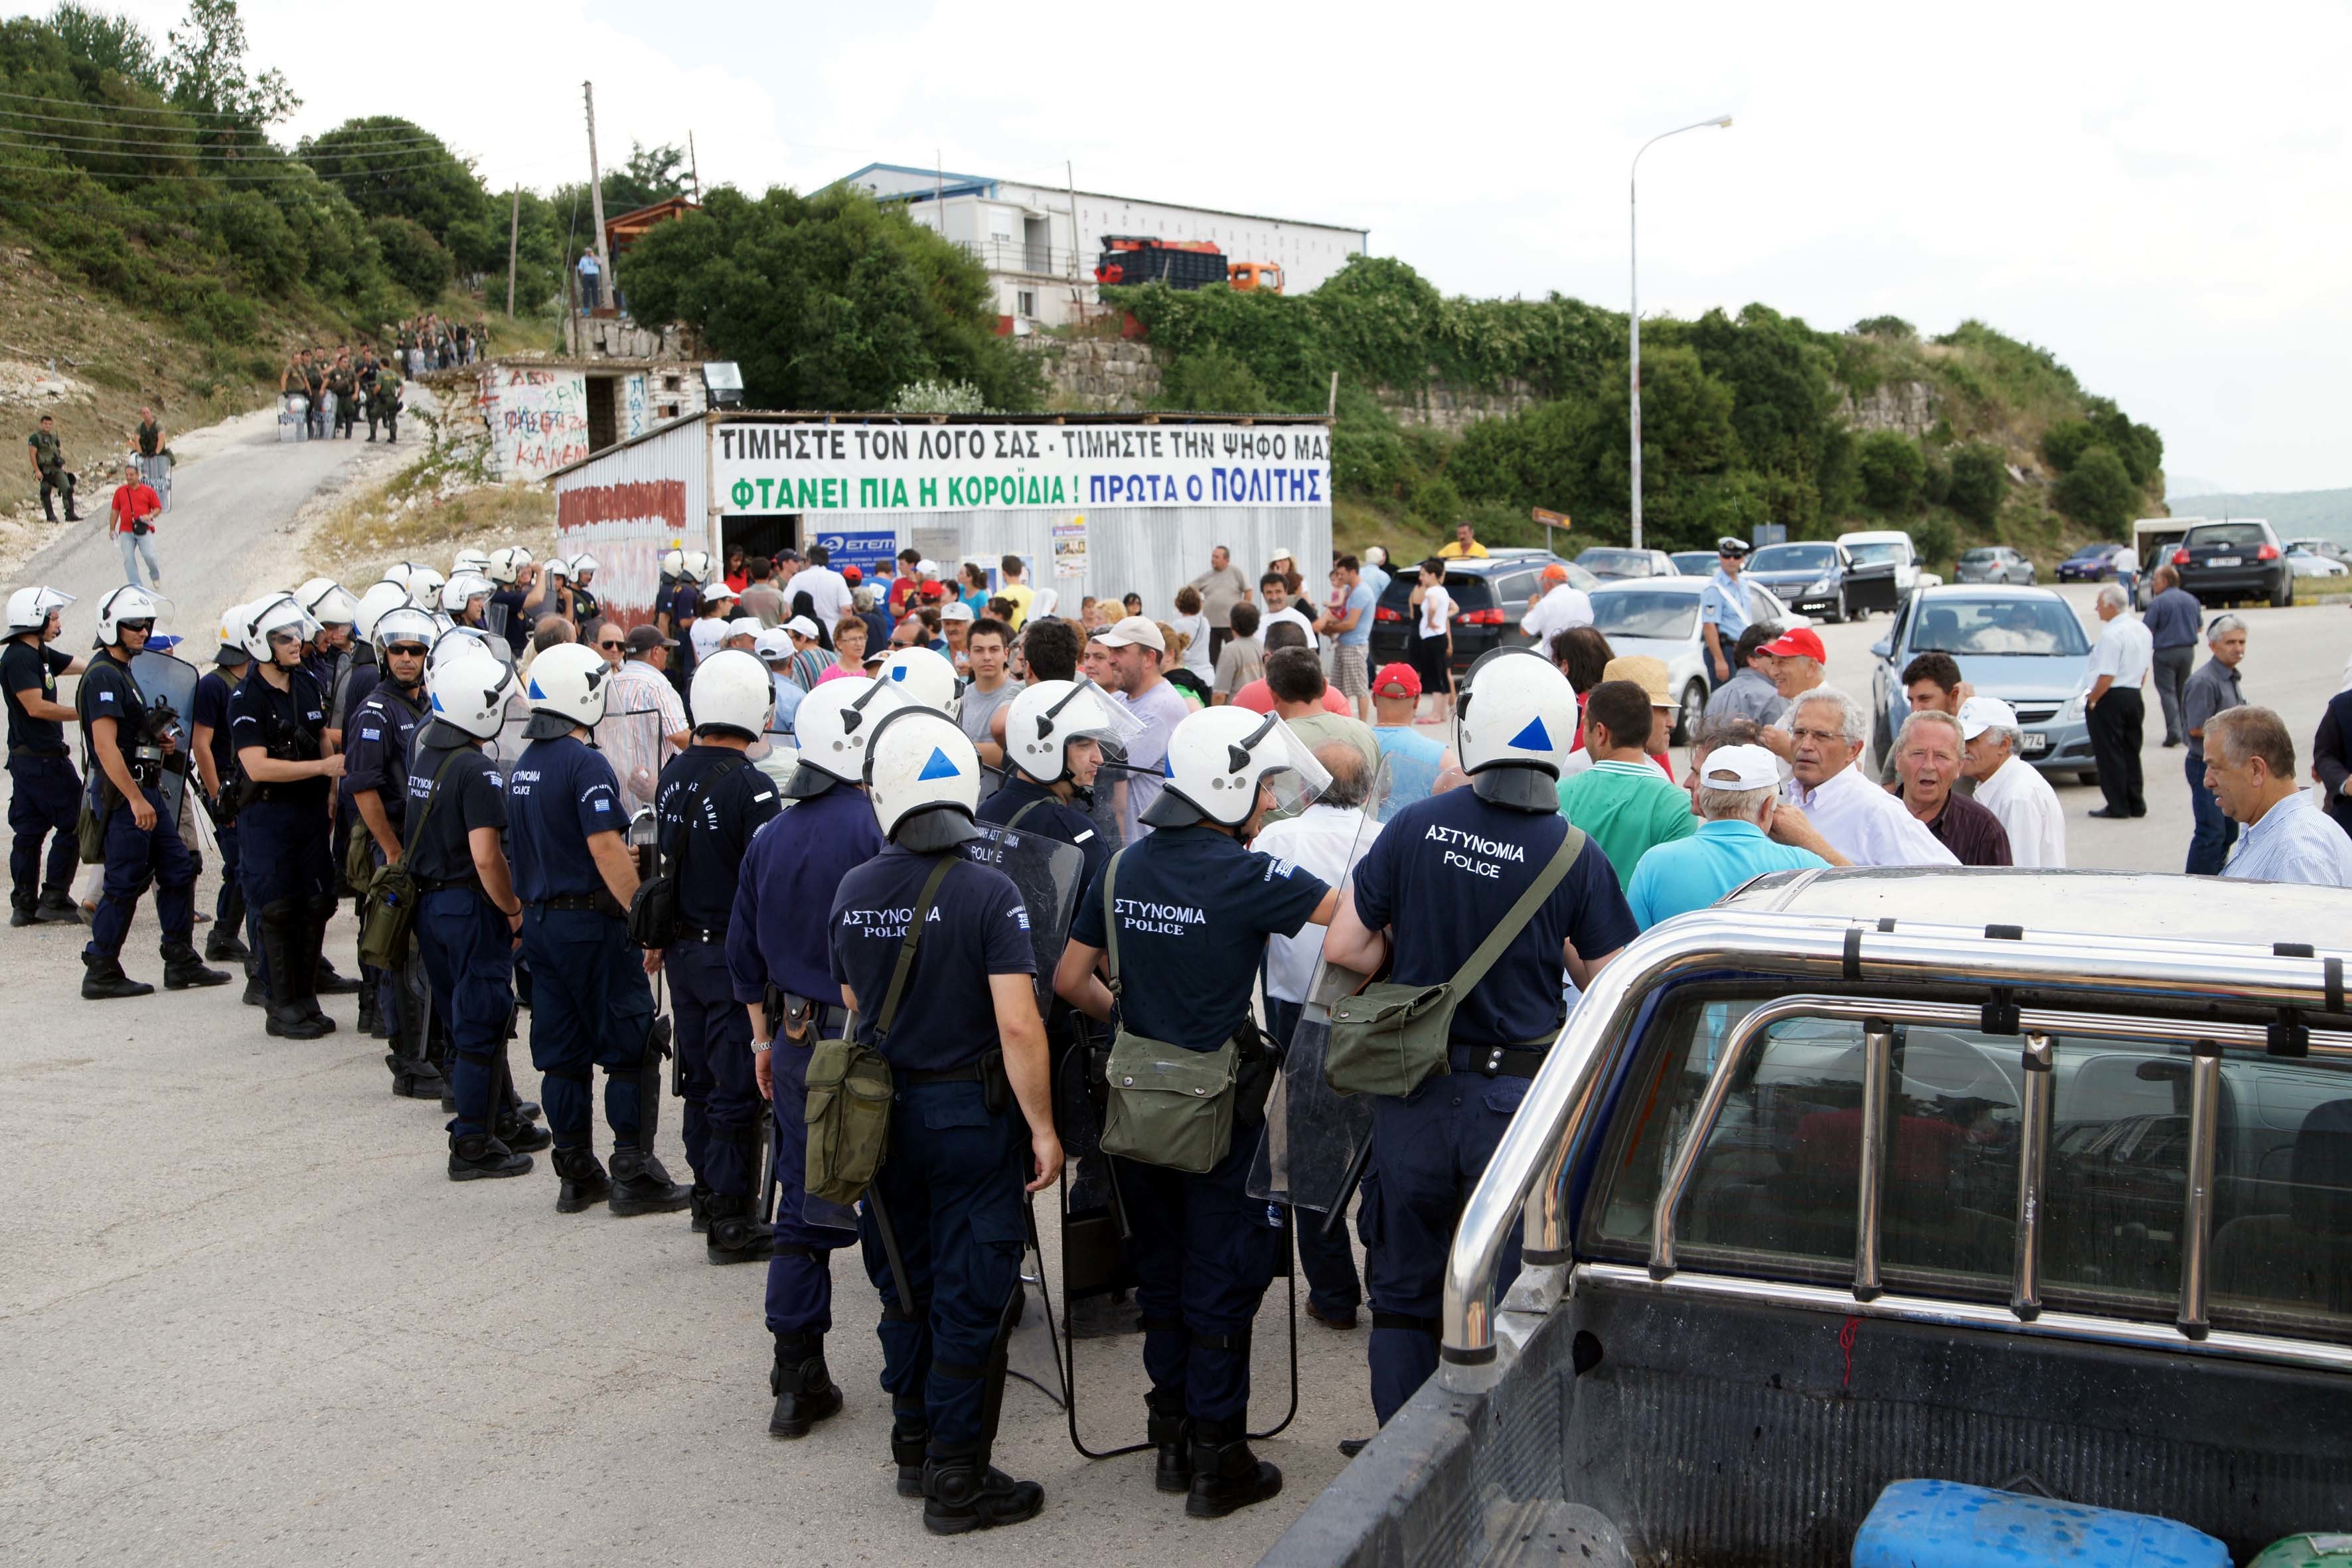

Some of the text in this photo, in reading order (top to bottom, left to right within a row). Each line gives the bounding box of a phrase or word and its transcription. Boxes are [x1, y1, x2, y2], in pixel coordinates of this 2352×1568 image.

[720, 430, 845, 459] ΤΙΜΗΣΤΕ
[855, 430, 908, 460] ΤΟΝ
[919, 430, 985, 459] ΛΟΓΟ
[994, 431, 1040, 458] ΣΑΣ
[1062, 431, 1163, 458] ΤΙΜΗΣΤΕ
[1170, 431, 1214, 458] ΤΗΝ
[1223, 433, 1286, 461] ΨΗΦΟ
[732, 477, 848, 510] ΦΤΑΝΕΙ
[860, 477, 909, 508] ΠΙΑ
[920, 477, 937, 507] Η
[1090, 475, 1178, 503] ΠΡΩΤΑ
[1187, 474, 1203, 502] Ο
[1212, 467, 1320, 503] ΠΟΛΙΤΗΣ
[659, 781, 680, 819] ΛΛΗΝΙΚΗ
[667, 814, 698, 828] POLE
[988, 829, 1020, 848] ΑΣΤΟΜΙΑ
[1425, 824, 1524, 862] ΑΣΤΥΝΟΜΙΑ
[971, 846, 1004, 863] POLIE
[1443, 850, 1501, 878] POLICE
[842, 905, 941, 926] ΑΣΤΥΝΟΙΑ
[1114, 898, 1206, 924] ΣΤΥΝΟΜΙΑ
[864, 925, 909, 937] POLIC
[1124, 917, 1184, 935] POLICE
